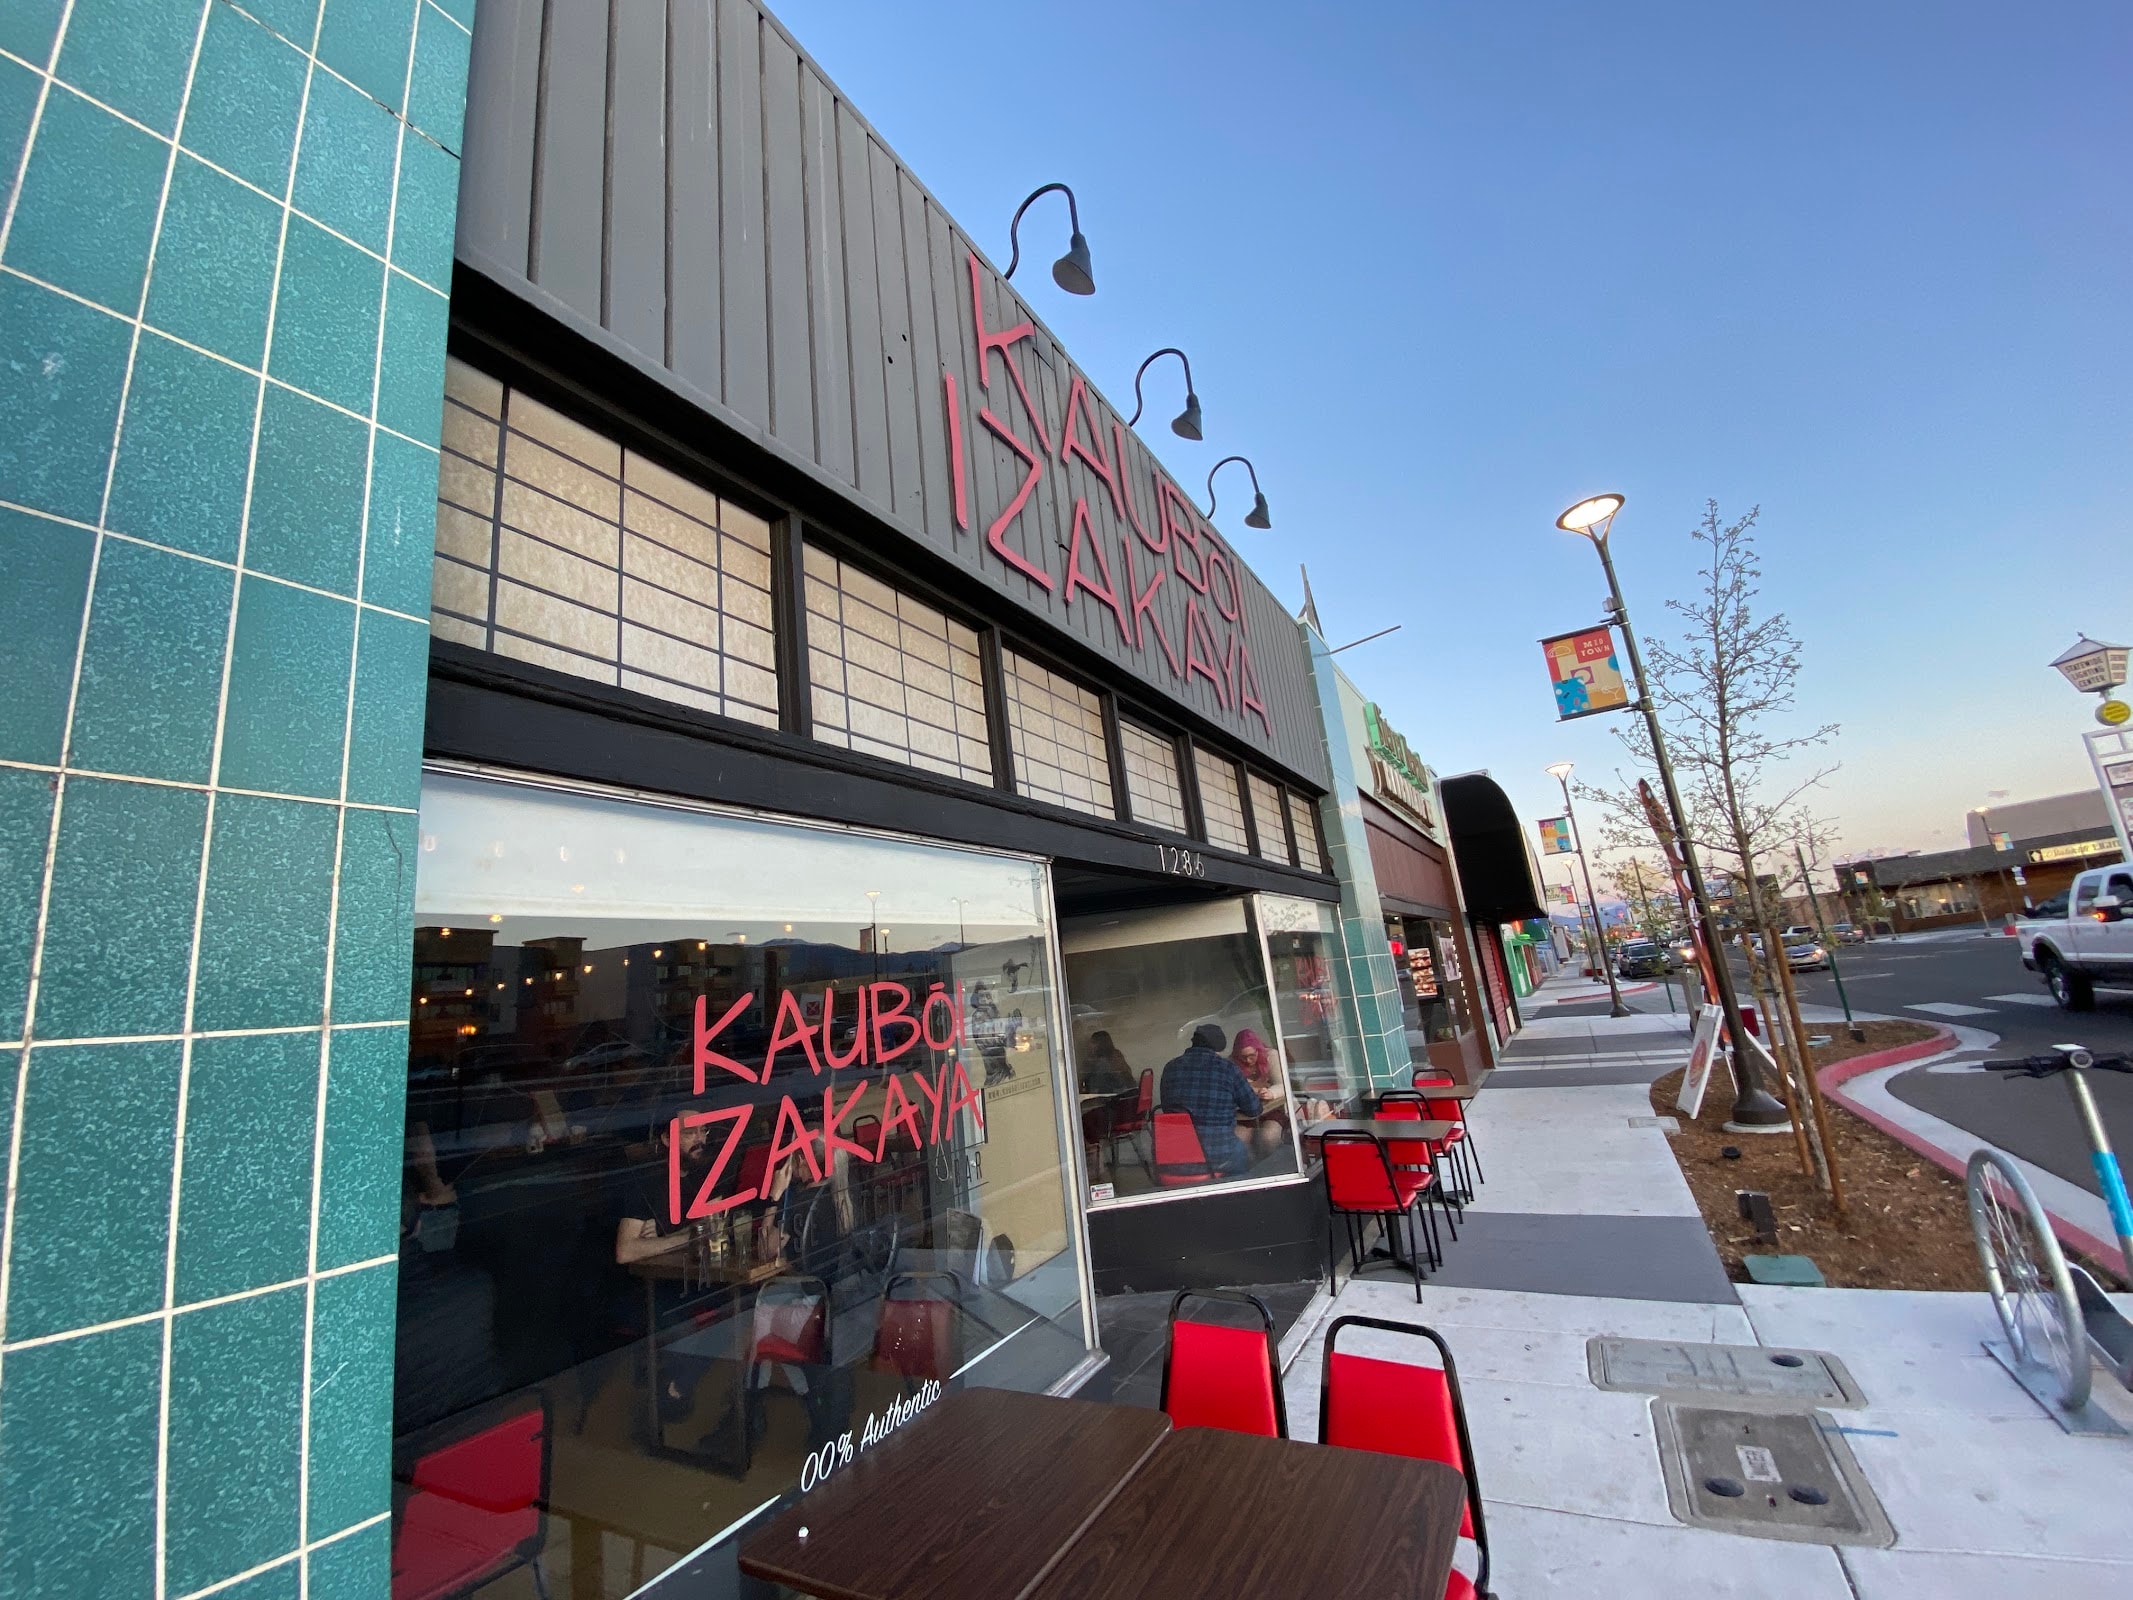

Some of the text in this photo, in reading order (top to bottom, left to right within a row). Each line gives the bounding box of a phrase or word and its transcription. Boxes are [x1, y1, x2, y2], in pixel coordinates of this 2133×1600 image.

[945, 372, 1272, 738] IZAKAYA
[1580, 644, 1611, 657] TOWN
[1582, 637, 1605, 650] MID
[2078, 675, 2106, 688] CENTER
[1159, 845, 1205, 877] 1286
[669, 1060, 985, 1225] IZAKAYA
[860, 1378, 942, 1453] Authentic
